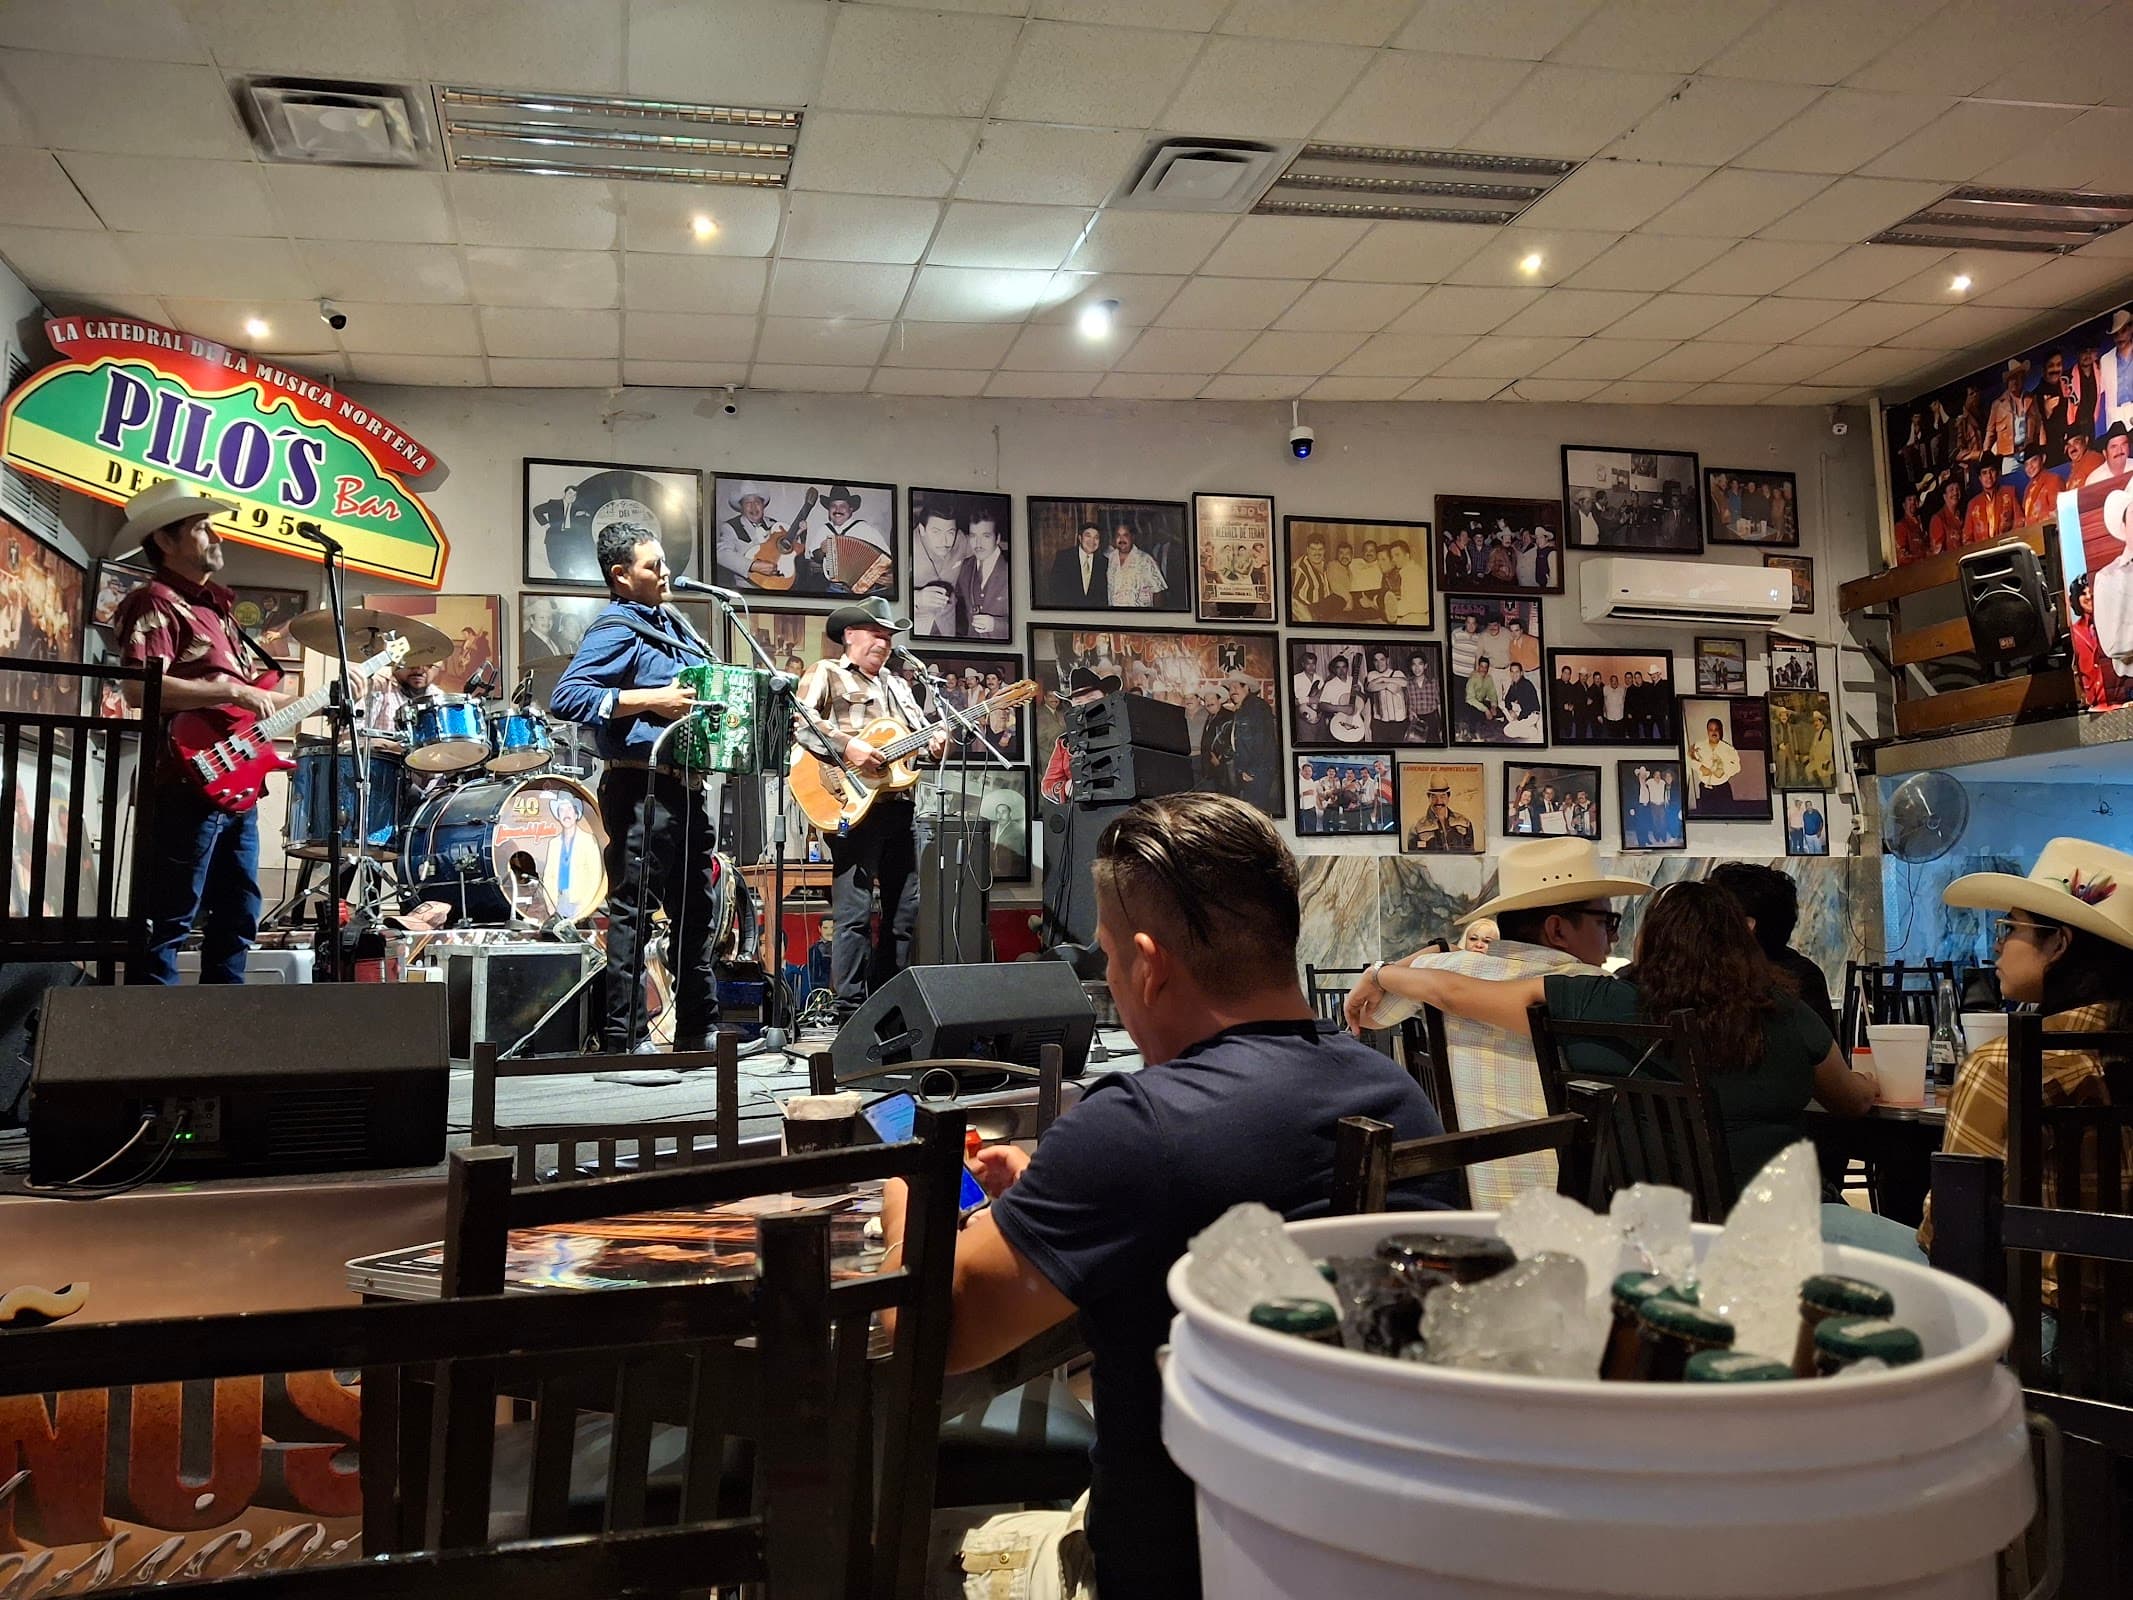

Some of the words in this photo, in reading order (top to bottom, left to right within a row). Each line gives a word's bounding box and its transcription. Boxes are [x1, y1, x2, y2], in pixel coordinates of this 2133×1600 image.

[52, 322, 79, 343] LA
[84, 321, 184, 352] CATEDRAL
[190, 339, 219, 361] DE
[222, 351, 248, 374] LA
[255, 363, 334, 409] MUSICA
[337, 400, 428, 471] NORTEÑA
[334, 477, 400, 521] Bar
[512, 797, 540, 816] 40
